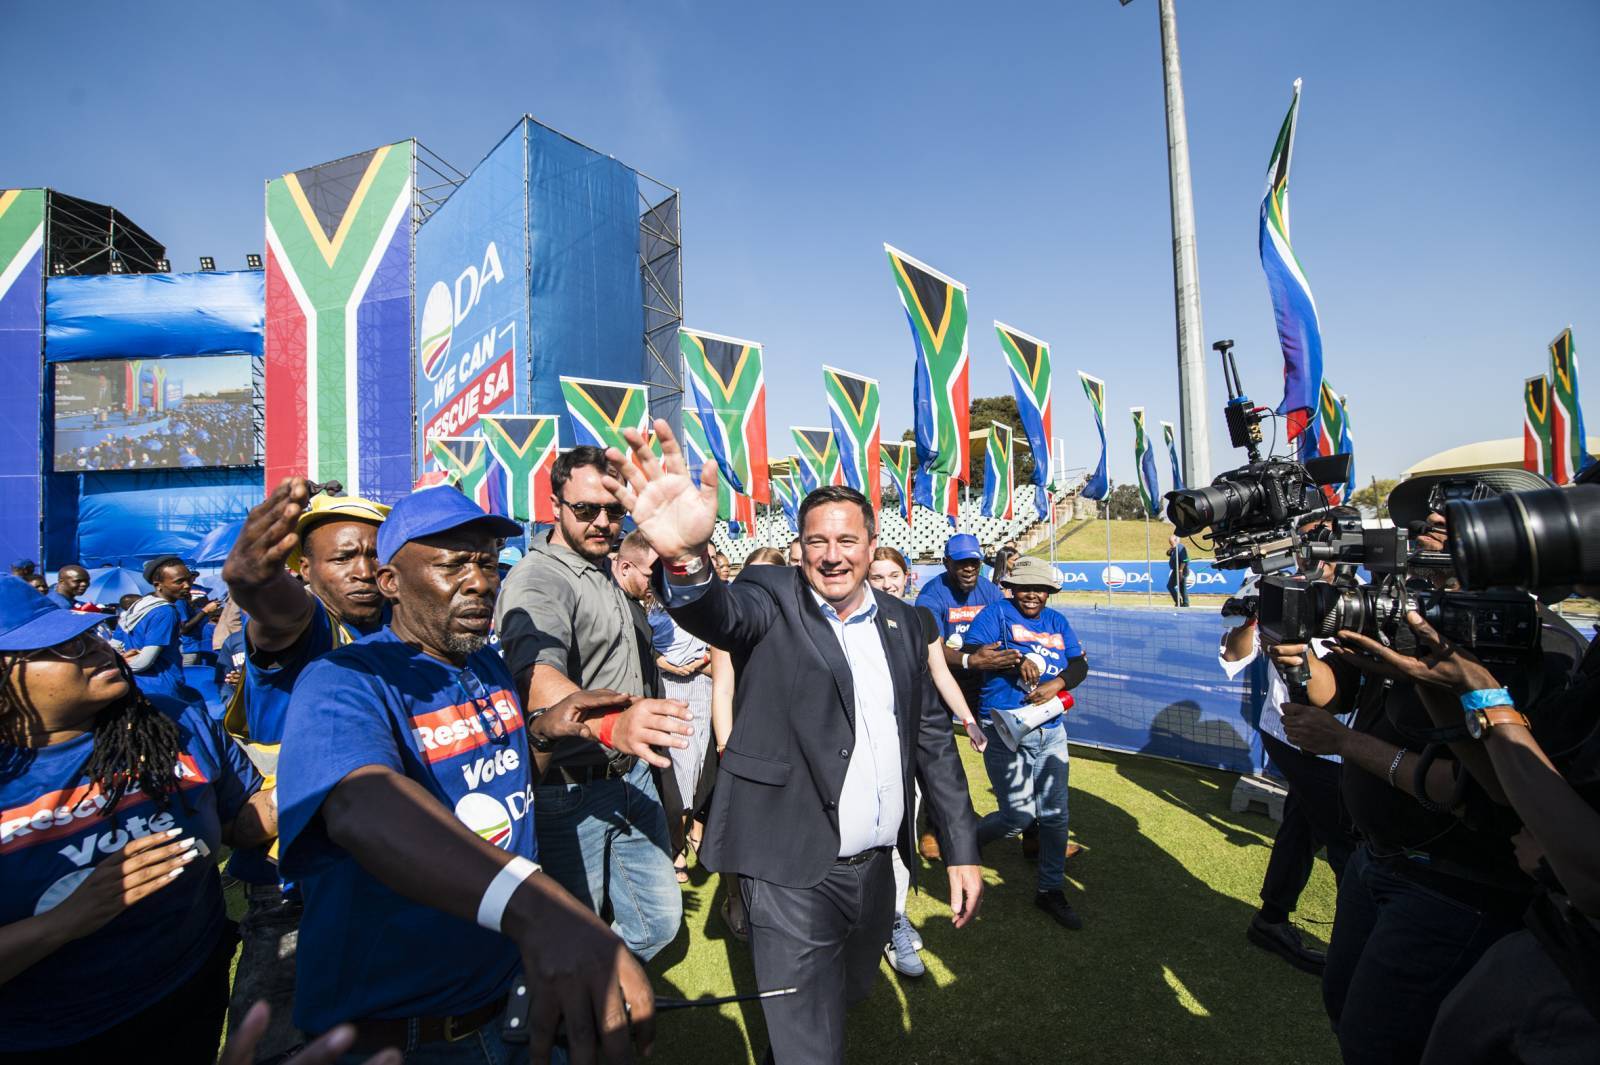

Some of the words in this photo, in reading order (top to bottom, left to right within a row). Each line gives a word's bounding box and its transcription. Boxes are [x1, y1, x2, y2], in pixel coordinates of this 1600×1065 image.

[454, 241, 505, 328] DA
[434, 364, 456, 409] WE
[459, 326, 496, 384] CAN
[425, 383, 480, 456] RESCUE
[483, 361, 509, 406] SA
[1064, 572, 1088, 583] DA
[1126, 572, 1153, 583] DA
[1197, 572, 1227, 584] DA
[1046, 664, 1063, 677] D
[462, 748, 520, 790] Vote
[58, 810, 176, 868] Vote
